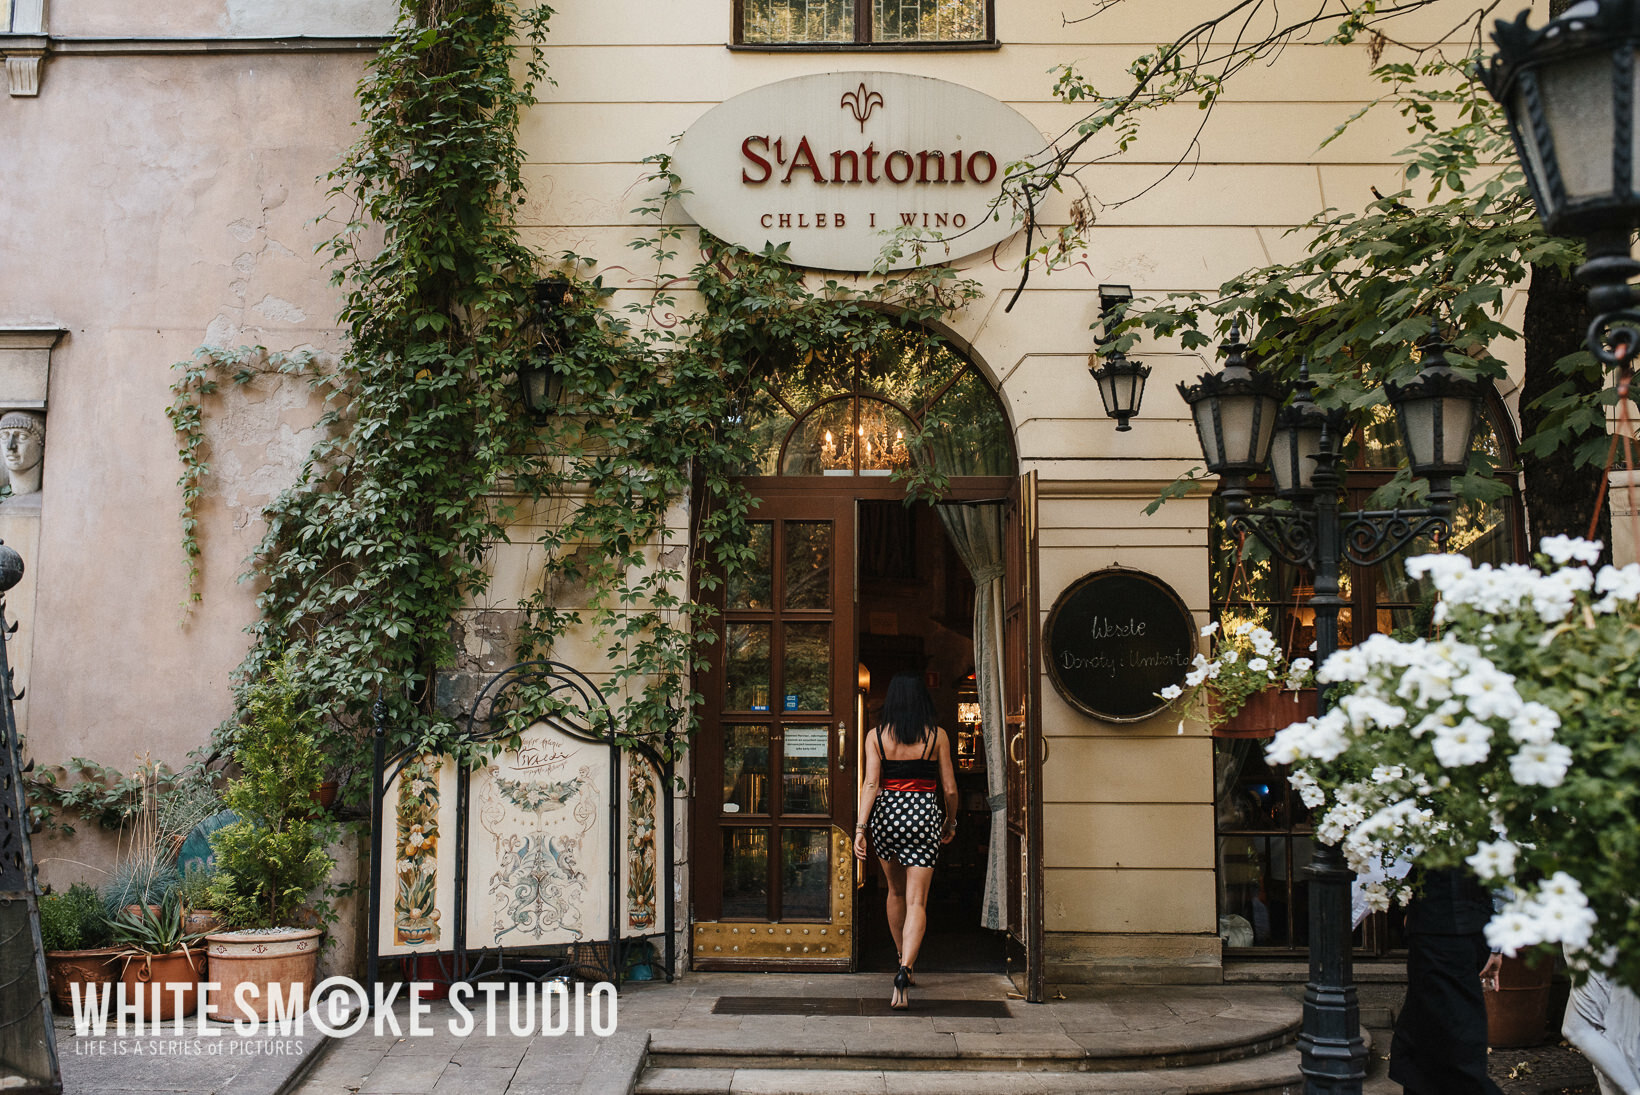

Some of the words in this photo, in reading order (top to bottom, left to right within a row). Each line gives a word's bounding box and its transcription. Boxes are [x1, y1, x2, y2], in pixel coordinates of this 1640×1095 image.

[760, 212, 846, 228] CHLEB
[870, 212, 876, 228] I
[900, 212, 967, 228] WINO
[1091, 615, 1146, 640] Wesele
[1129, 647, 1189, 667] Umberto
